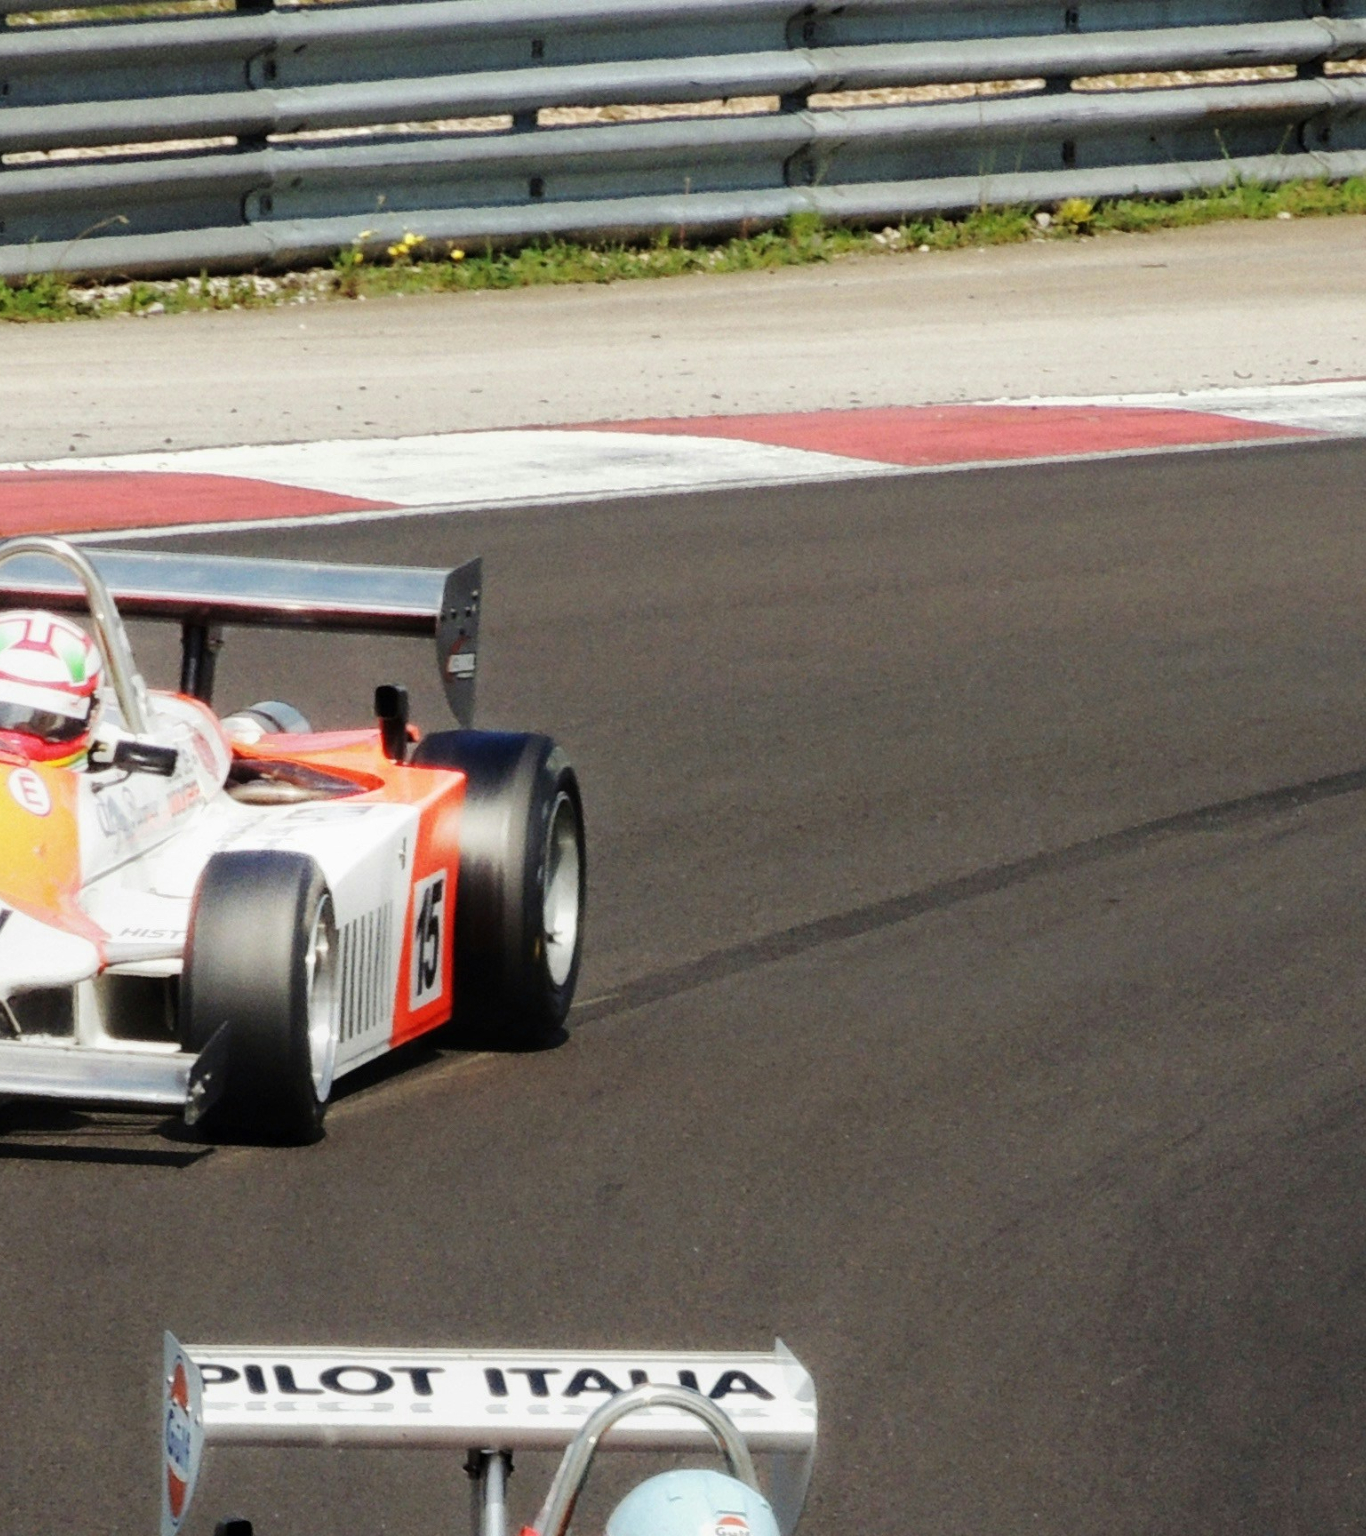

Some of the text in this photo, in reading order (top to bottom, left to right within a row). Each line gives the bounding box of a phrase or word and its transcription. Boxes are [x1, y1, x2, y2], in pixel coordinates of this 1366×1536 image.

[117, 927, 186, 939] HIST
[415, 879, 444, 996] 15
[197, 1363, 445, 1397] PILOT
